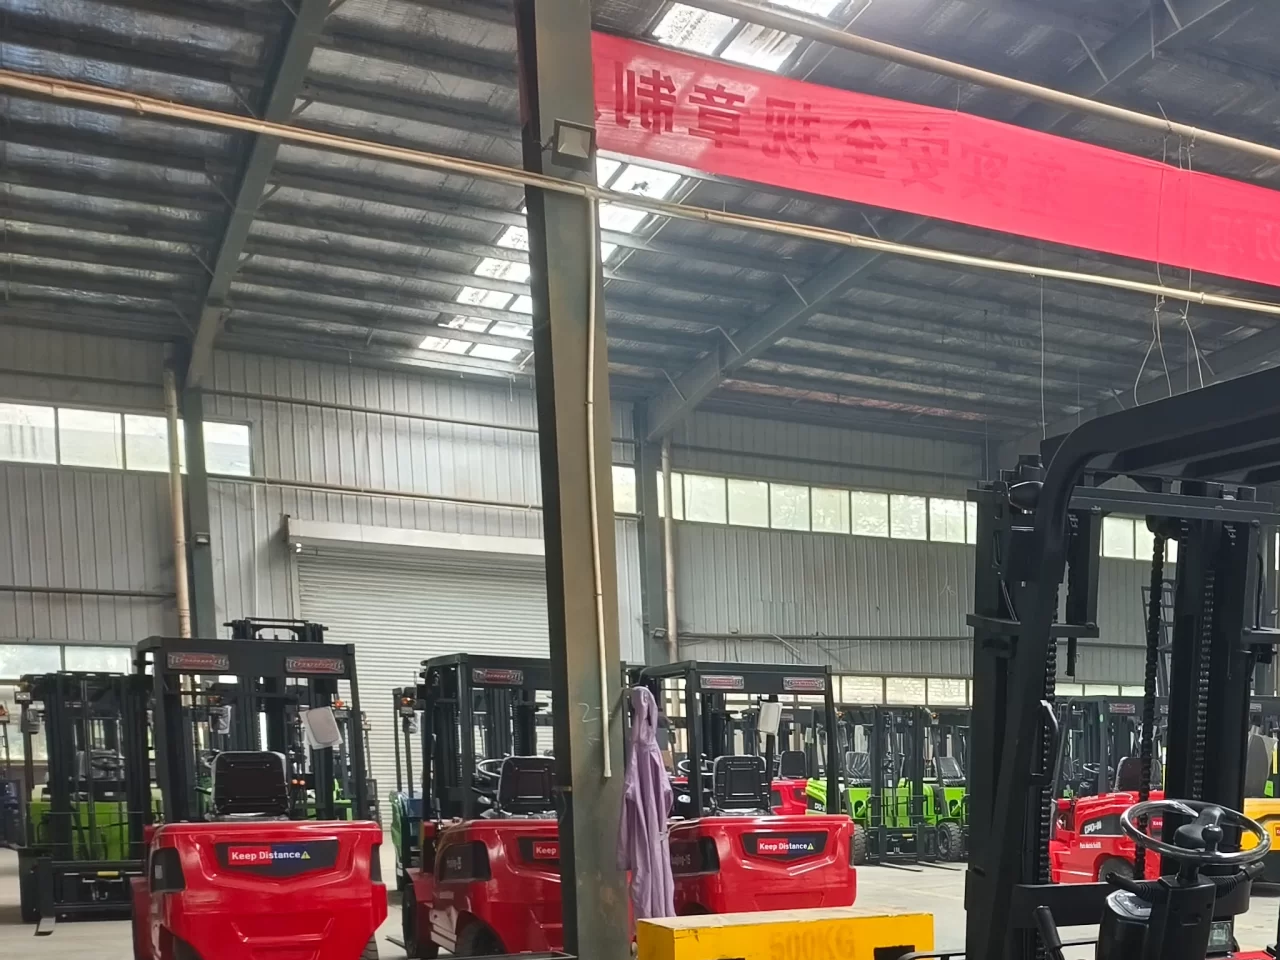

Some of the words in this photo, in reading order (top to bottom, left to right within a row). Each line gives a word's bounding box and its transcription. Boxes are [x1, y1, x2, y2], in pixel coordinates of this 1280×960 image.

[536, 847, 556, 855] Keep
[759, 843, 777, 851] Keep
[779, 842, 808, 850] Distance
[231, 852, 257, 861] Keep
[259, 851, 300, 859] Distance
